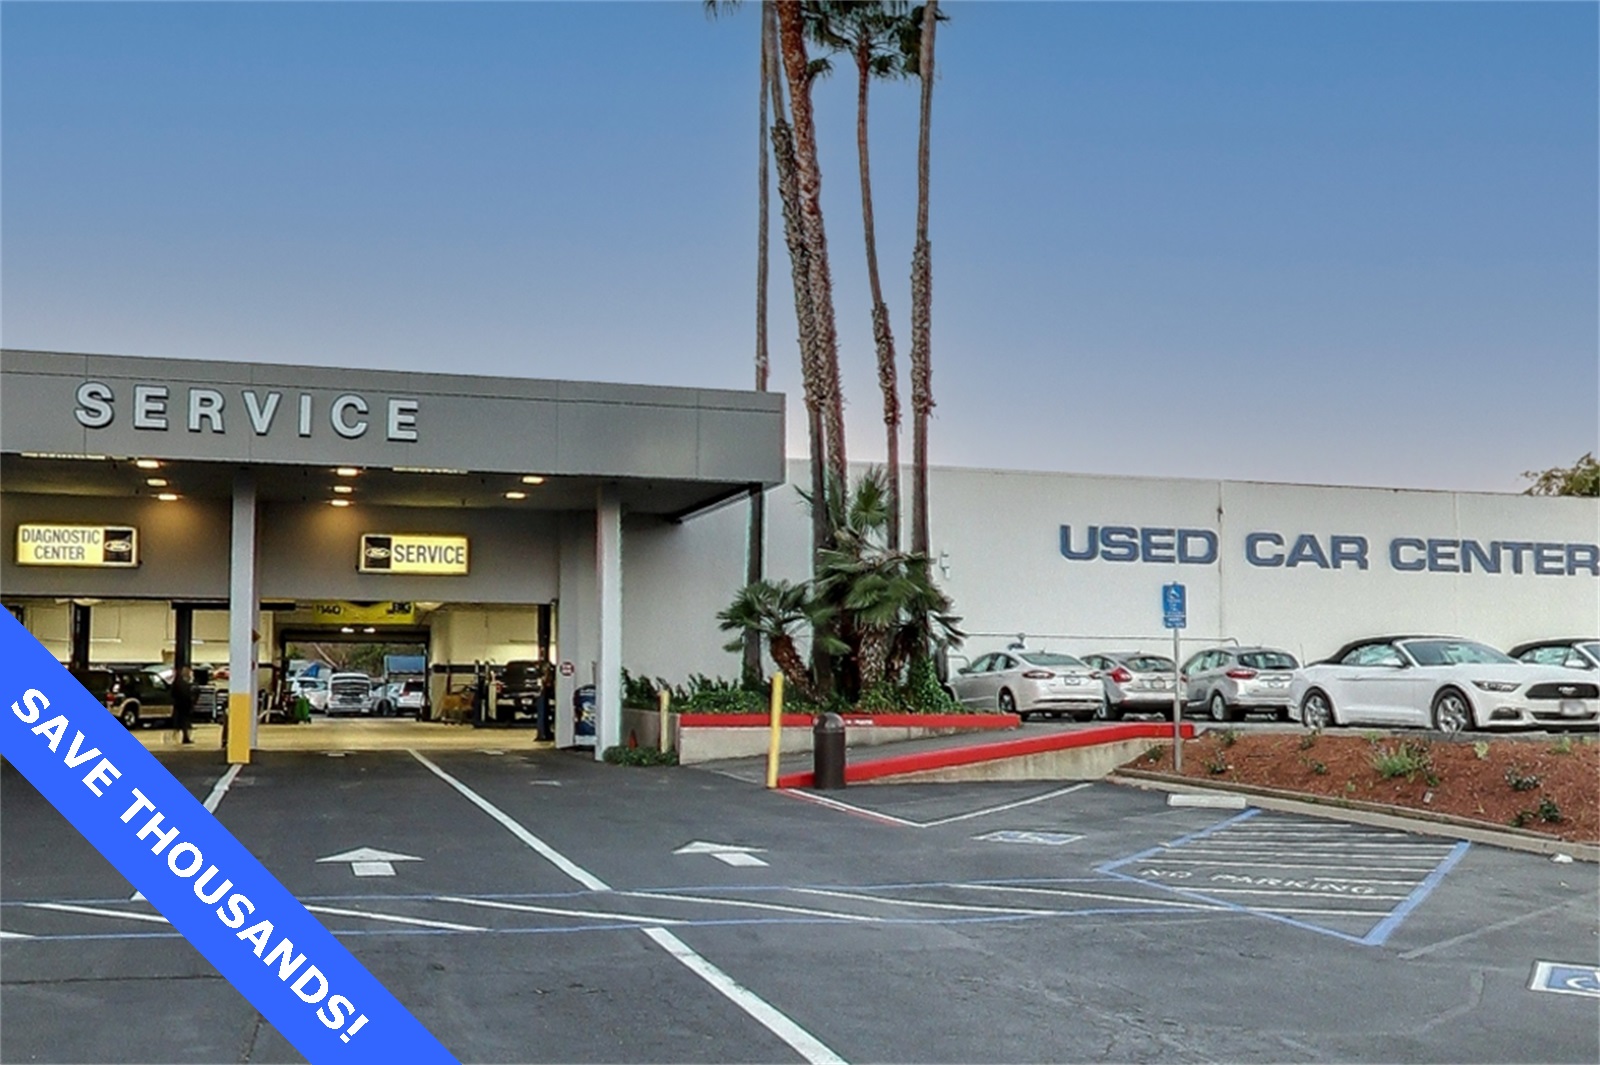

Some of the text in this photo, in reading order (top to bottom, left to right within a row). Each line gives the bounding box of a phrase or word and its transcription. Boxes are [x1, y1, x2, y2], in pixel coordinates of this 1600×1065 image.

[75, 382, 419, 440] SERVICE
[21, 528, 101, 545] DIAGNOSTIC
[34, 545, 86, 560] CENTER
[394, 544, 465, 565] SERVICE
[1060, 525, 1600, 576] USED CAR CENTER
[1138, 868, 1377, 894] NO PARKING
